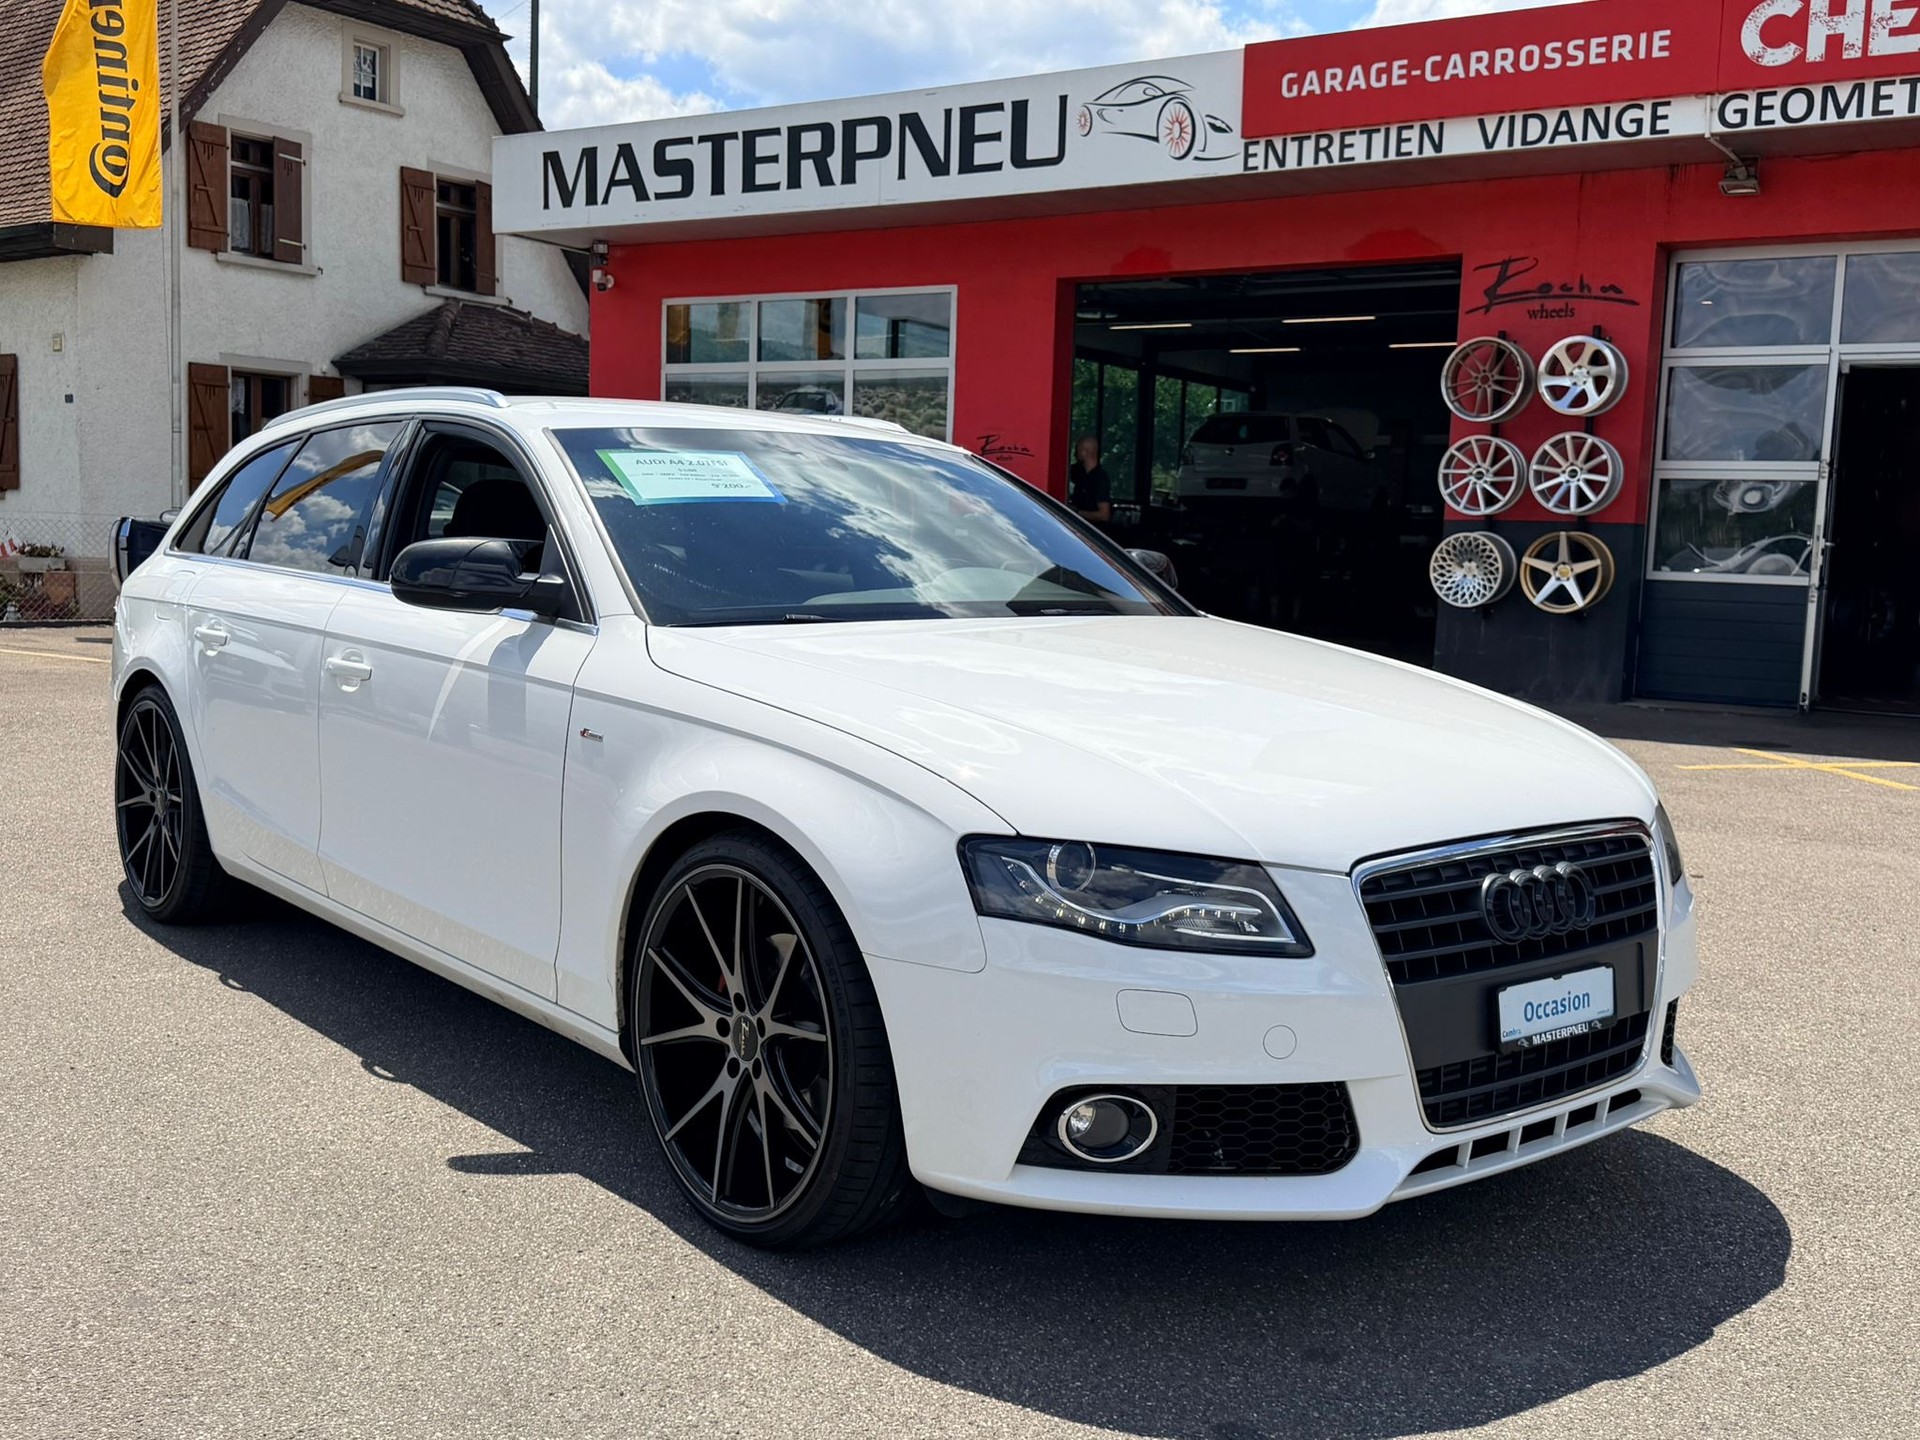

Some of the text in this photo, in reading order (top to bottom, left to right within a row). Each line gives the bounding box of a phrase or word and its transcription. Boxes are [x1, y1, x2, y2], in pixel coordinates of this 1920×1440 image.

[1741, 0, 1920, 66] CHE
[1281, 29, 1671, 98] GARAGE-CARROSSERIE
[543, 95, 1069, 210] MASTERPNEU
[1243, 121, 1444, 171] ENTRETIEN
[1478, 101, 1671, 149] VIDANGE
[1527, 302, 1576, 319] wheels
[635, 458, 666, 466] AUDI
[1524, 991, 1591, 1022] Occasion
[1532, 1022, 1589, 1046] MASTERPNEU
